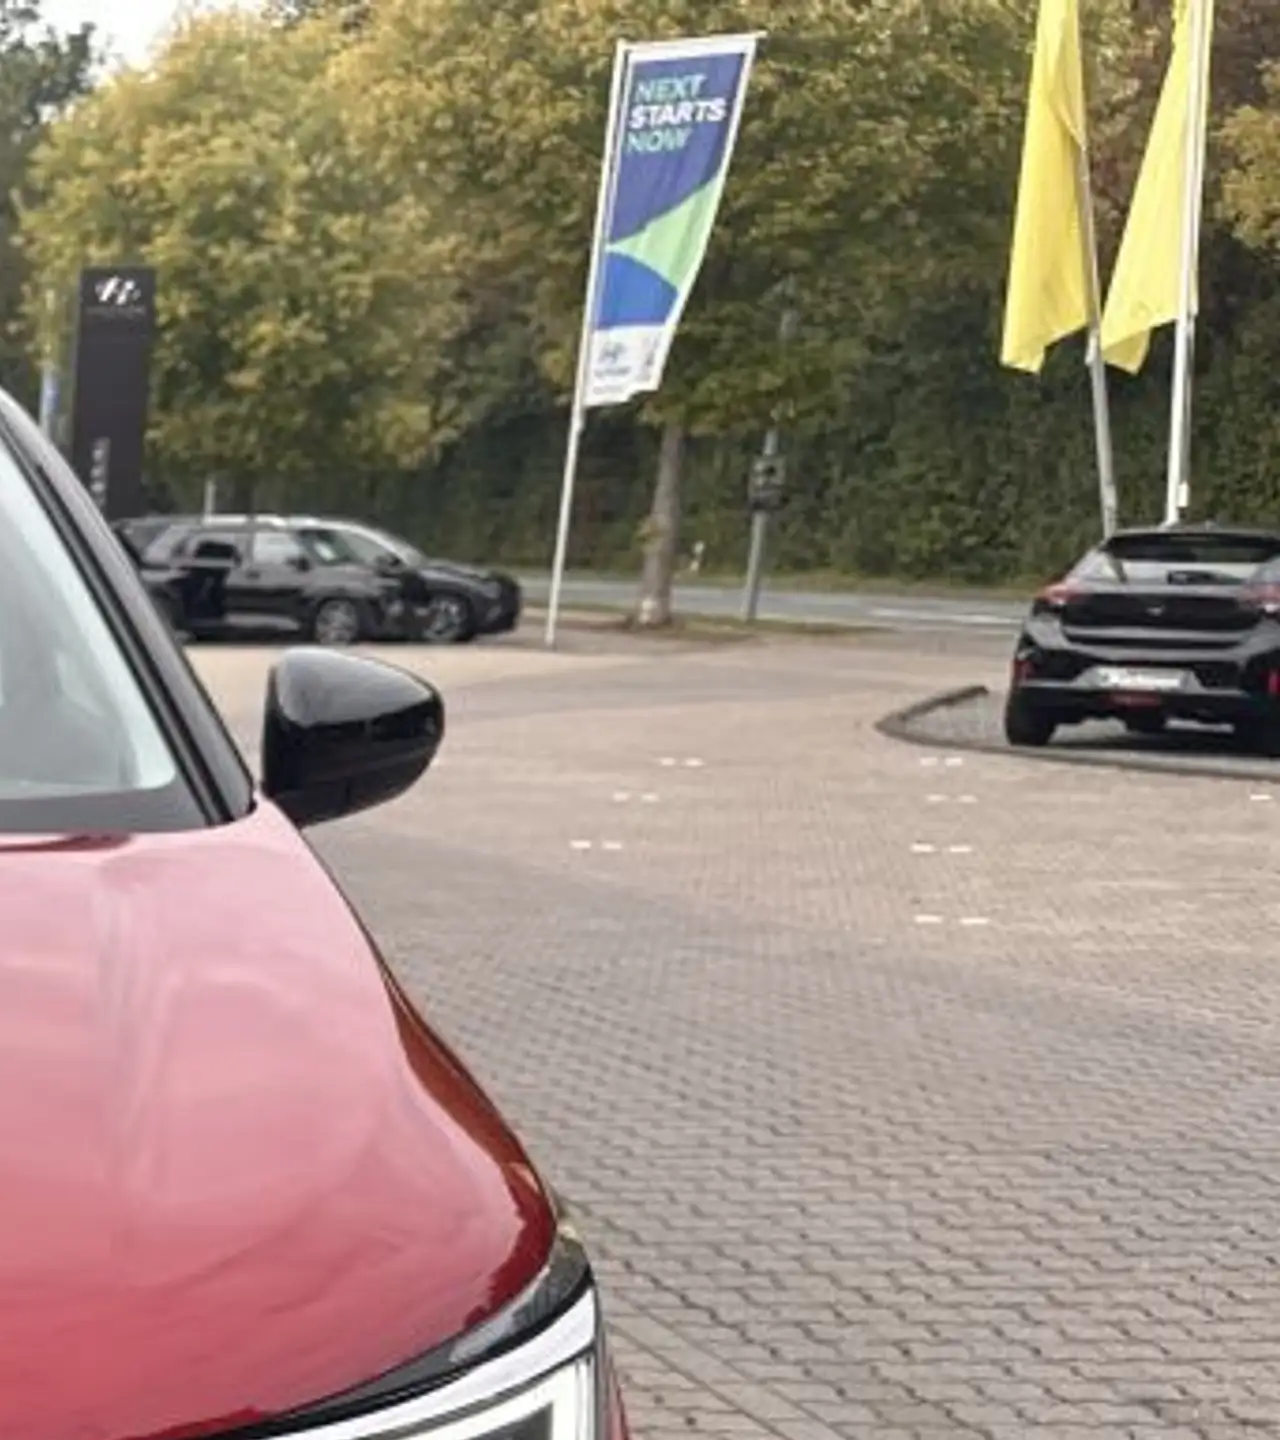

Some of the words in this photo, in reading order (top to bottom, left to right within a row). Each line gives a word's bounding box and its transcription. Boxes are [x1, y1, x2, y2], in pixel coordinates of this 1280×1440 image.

[635, 73, 707, 101] NEXT
[629, 97, 726, 130] STARTS
[626, 128, 692, 154] NOW
